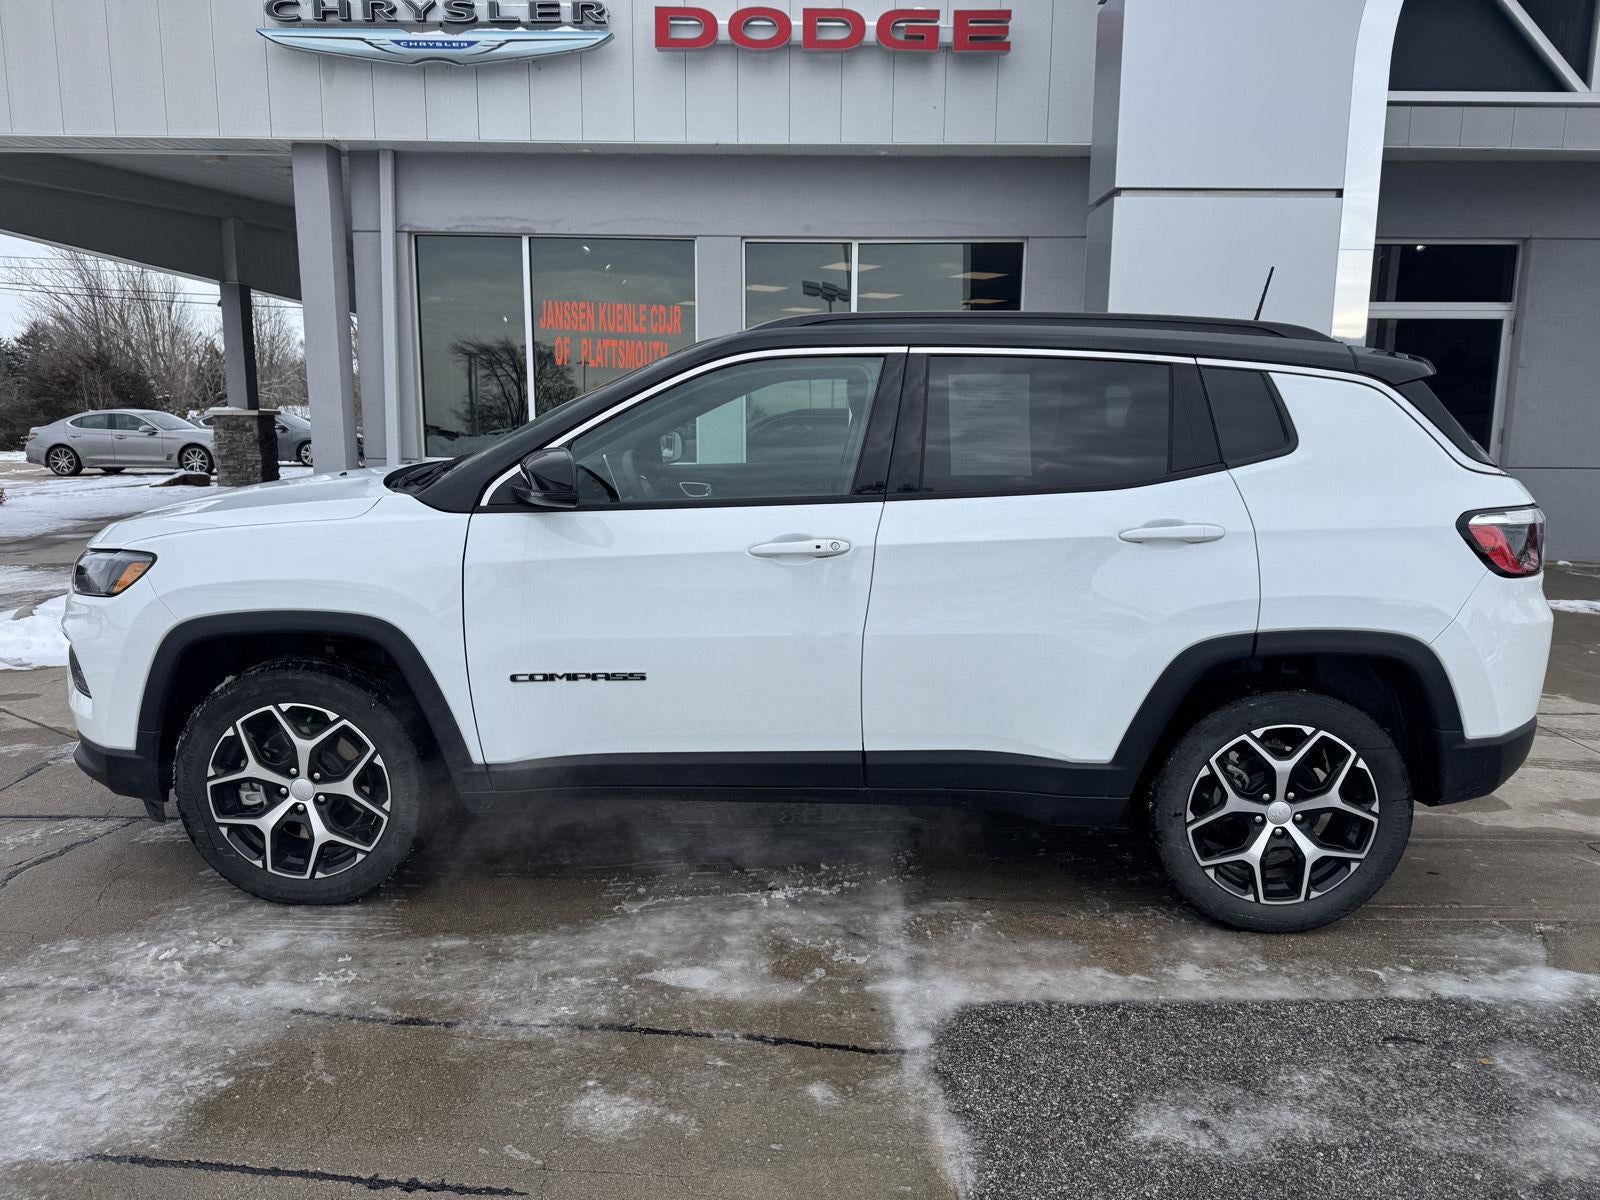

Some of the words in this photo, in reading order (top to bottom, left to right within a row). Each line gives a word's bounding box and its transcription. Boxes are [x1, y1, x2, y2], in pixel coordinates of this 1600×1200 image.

[264, 0, 609, 24] CHRYSLER
[655, 6, 1012, 53] DODGE
[539, 301, 595, 331] JANSSEN
[599, 302, 647, 333] KUENLE
[650, 304, 682, 336] CDJR
[554, 336, 571, 367] OF
[509, 672, 647, 683] COMPASS
